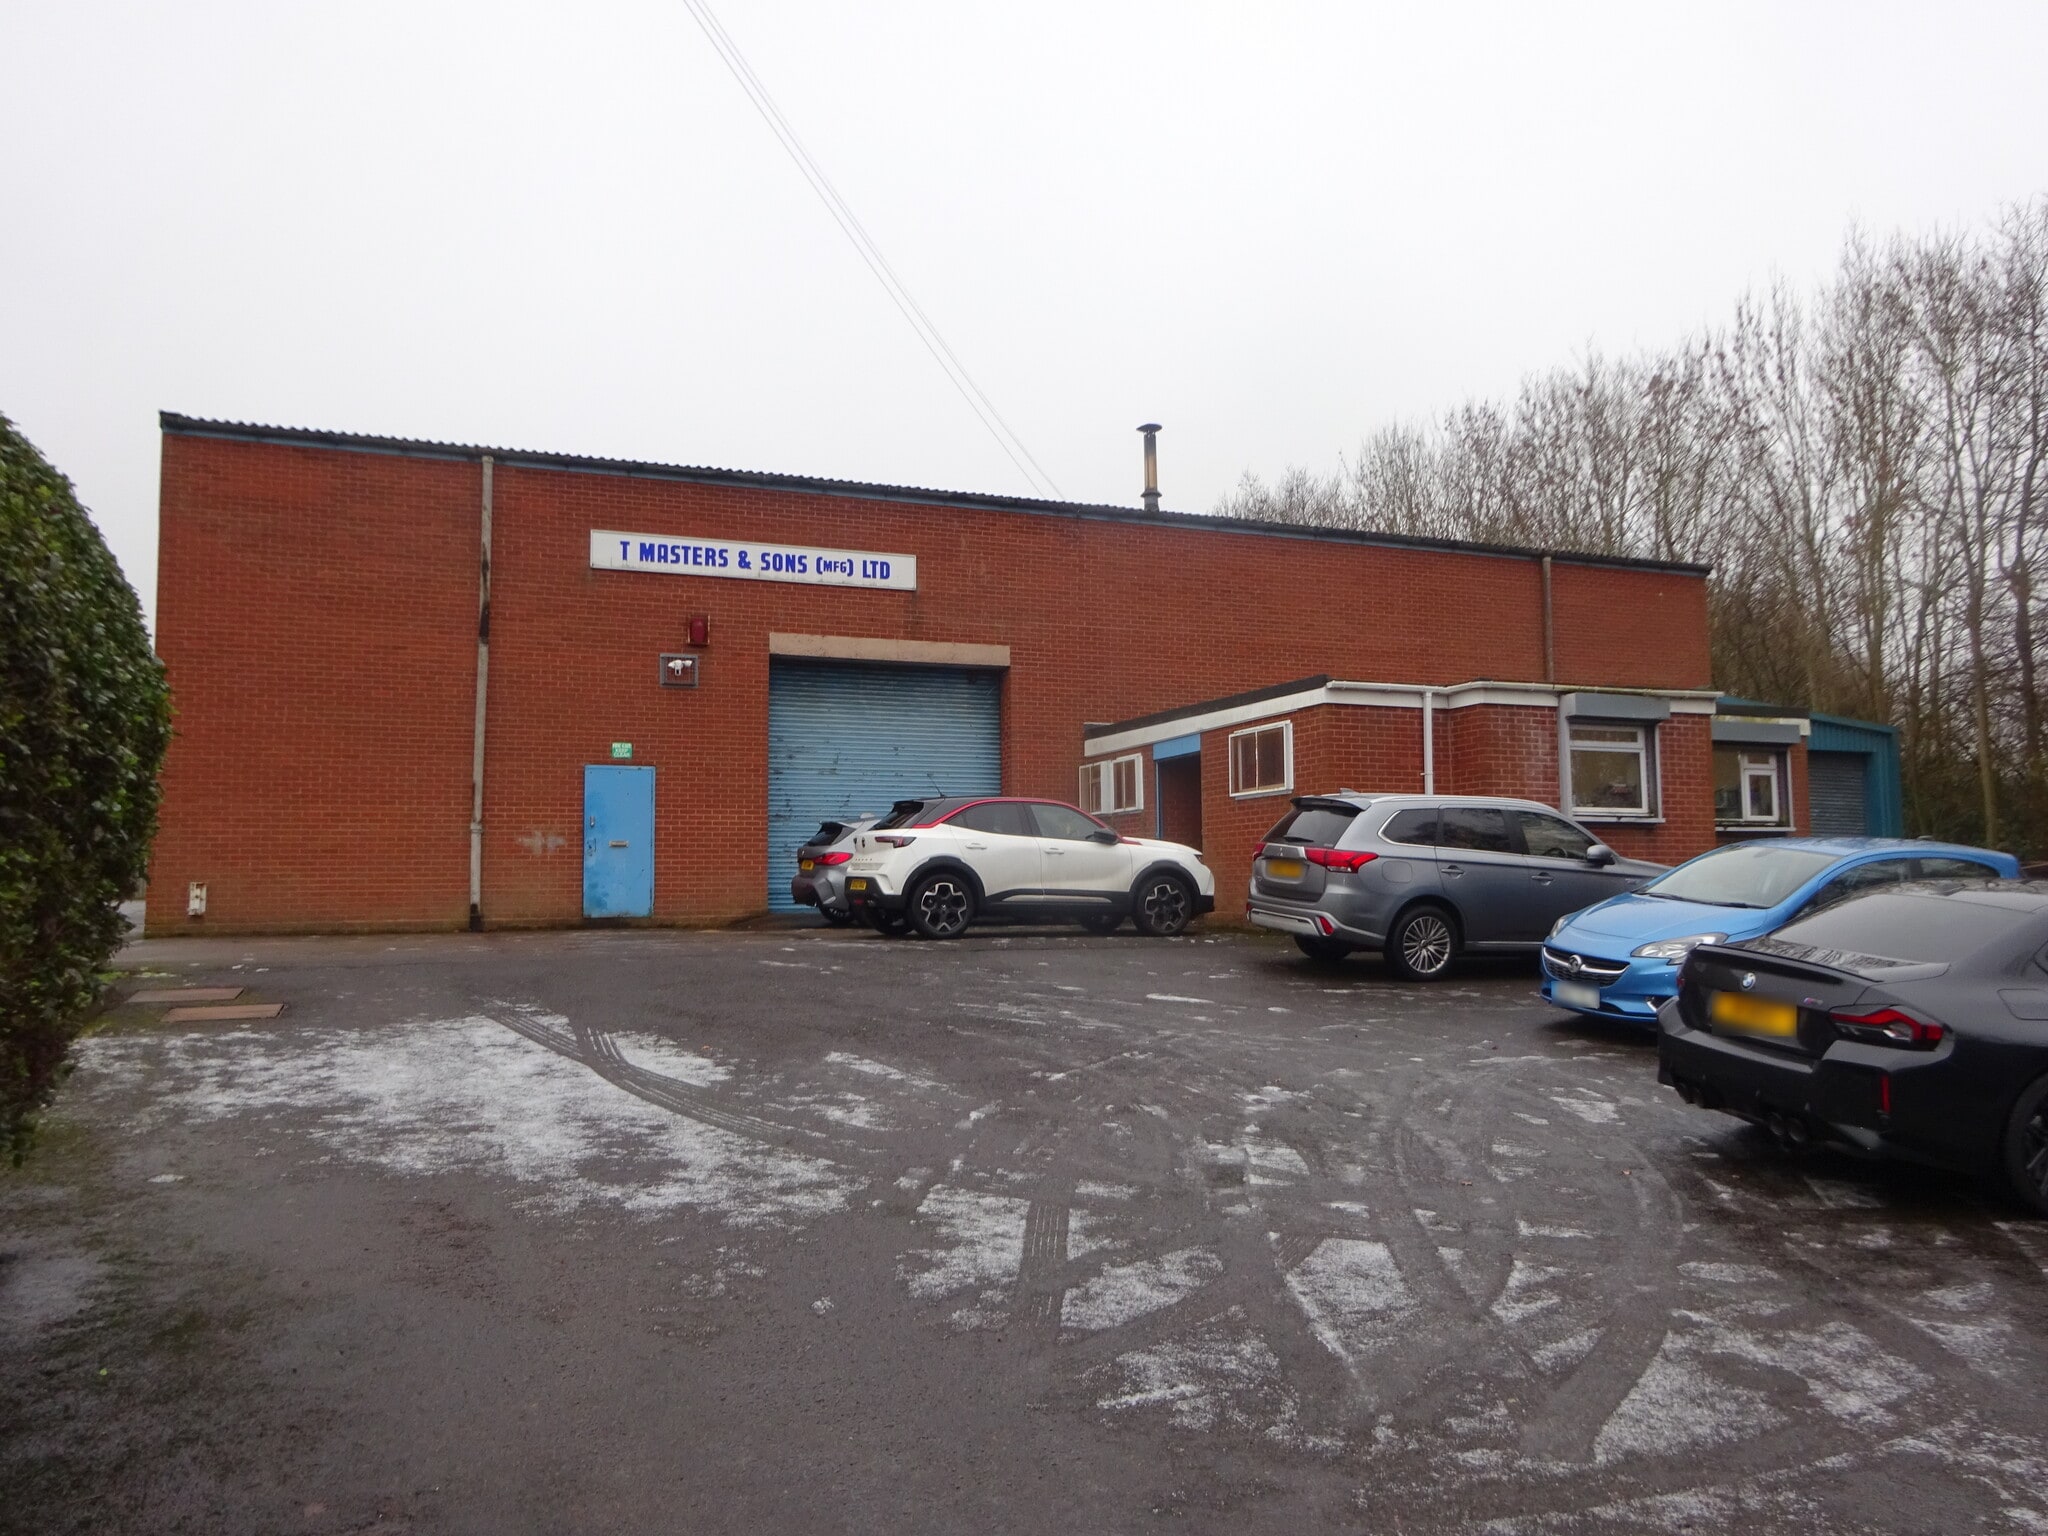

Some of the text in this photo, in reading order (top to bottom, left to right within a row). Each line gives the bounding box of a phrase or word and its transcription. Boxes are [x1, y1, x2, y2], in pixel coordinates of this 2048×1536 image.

[620, 541, 891, 579] T MASTERS & SONS (MFG) LTD
